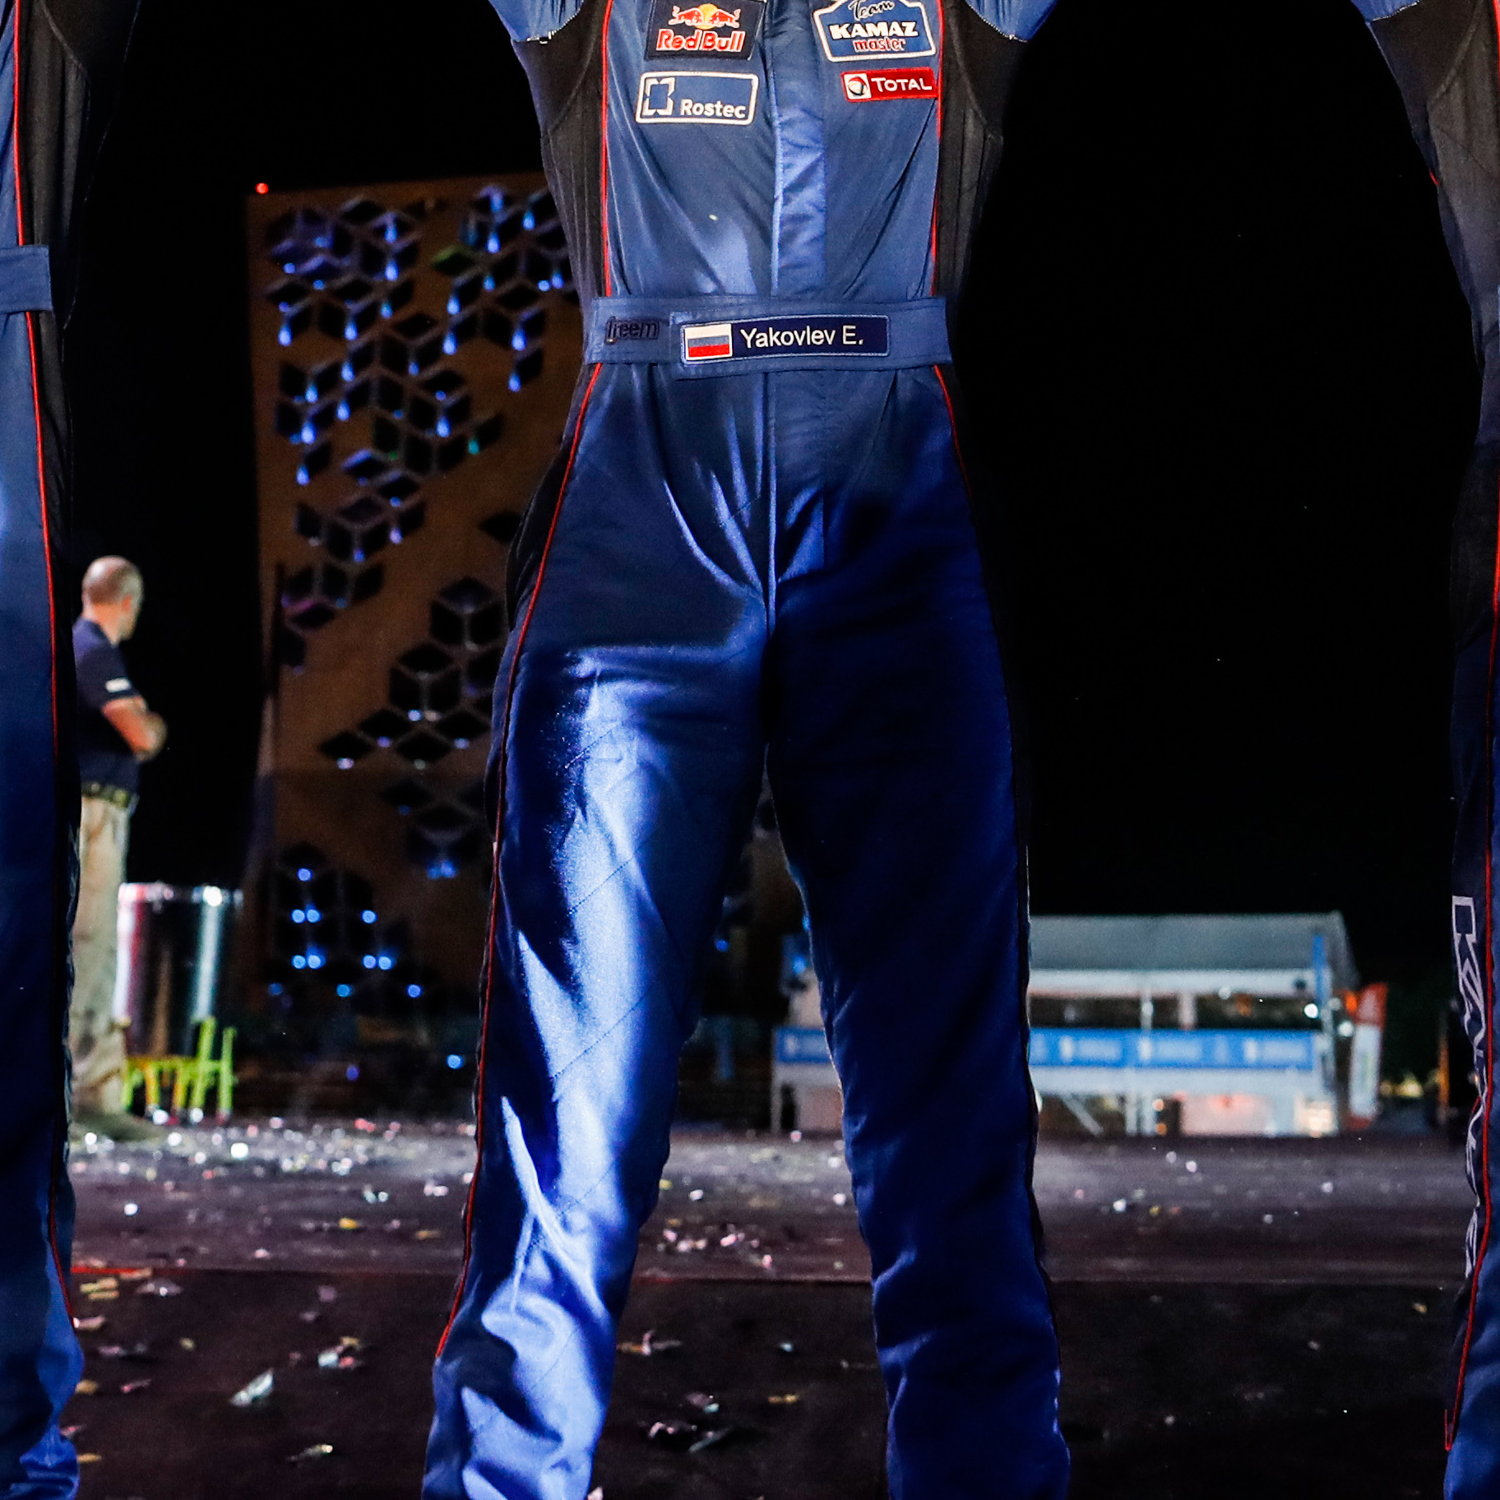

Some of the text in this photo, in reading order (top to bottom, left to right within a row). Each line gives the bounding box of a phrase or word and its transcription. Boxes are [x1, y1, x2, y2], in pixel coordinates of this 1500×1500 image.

[828, 20, 919, 39] KAMAZ
[853, 36, 907, 52] master
[679, 98, 747, 120] Rostec
[739, 325, 865, 349] Yakovlev E.
